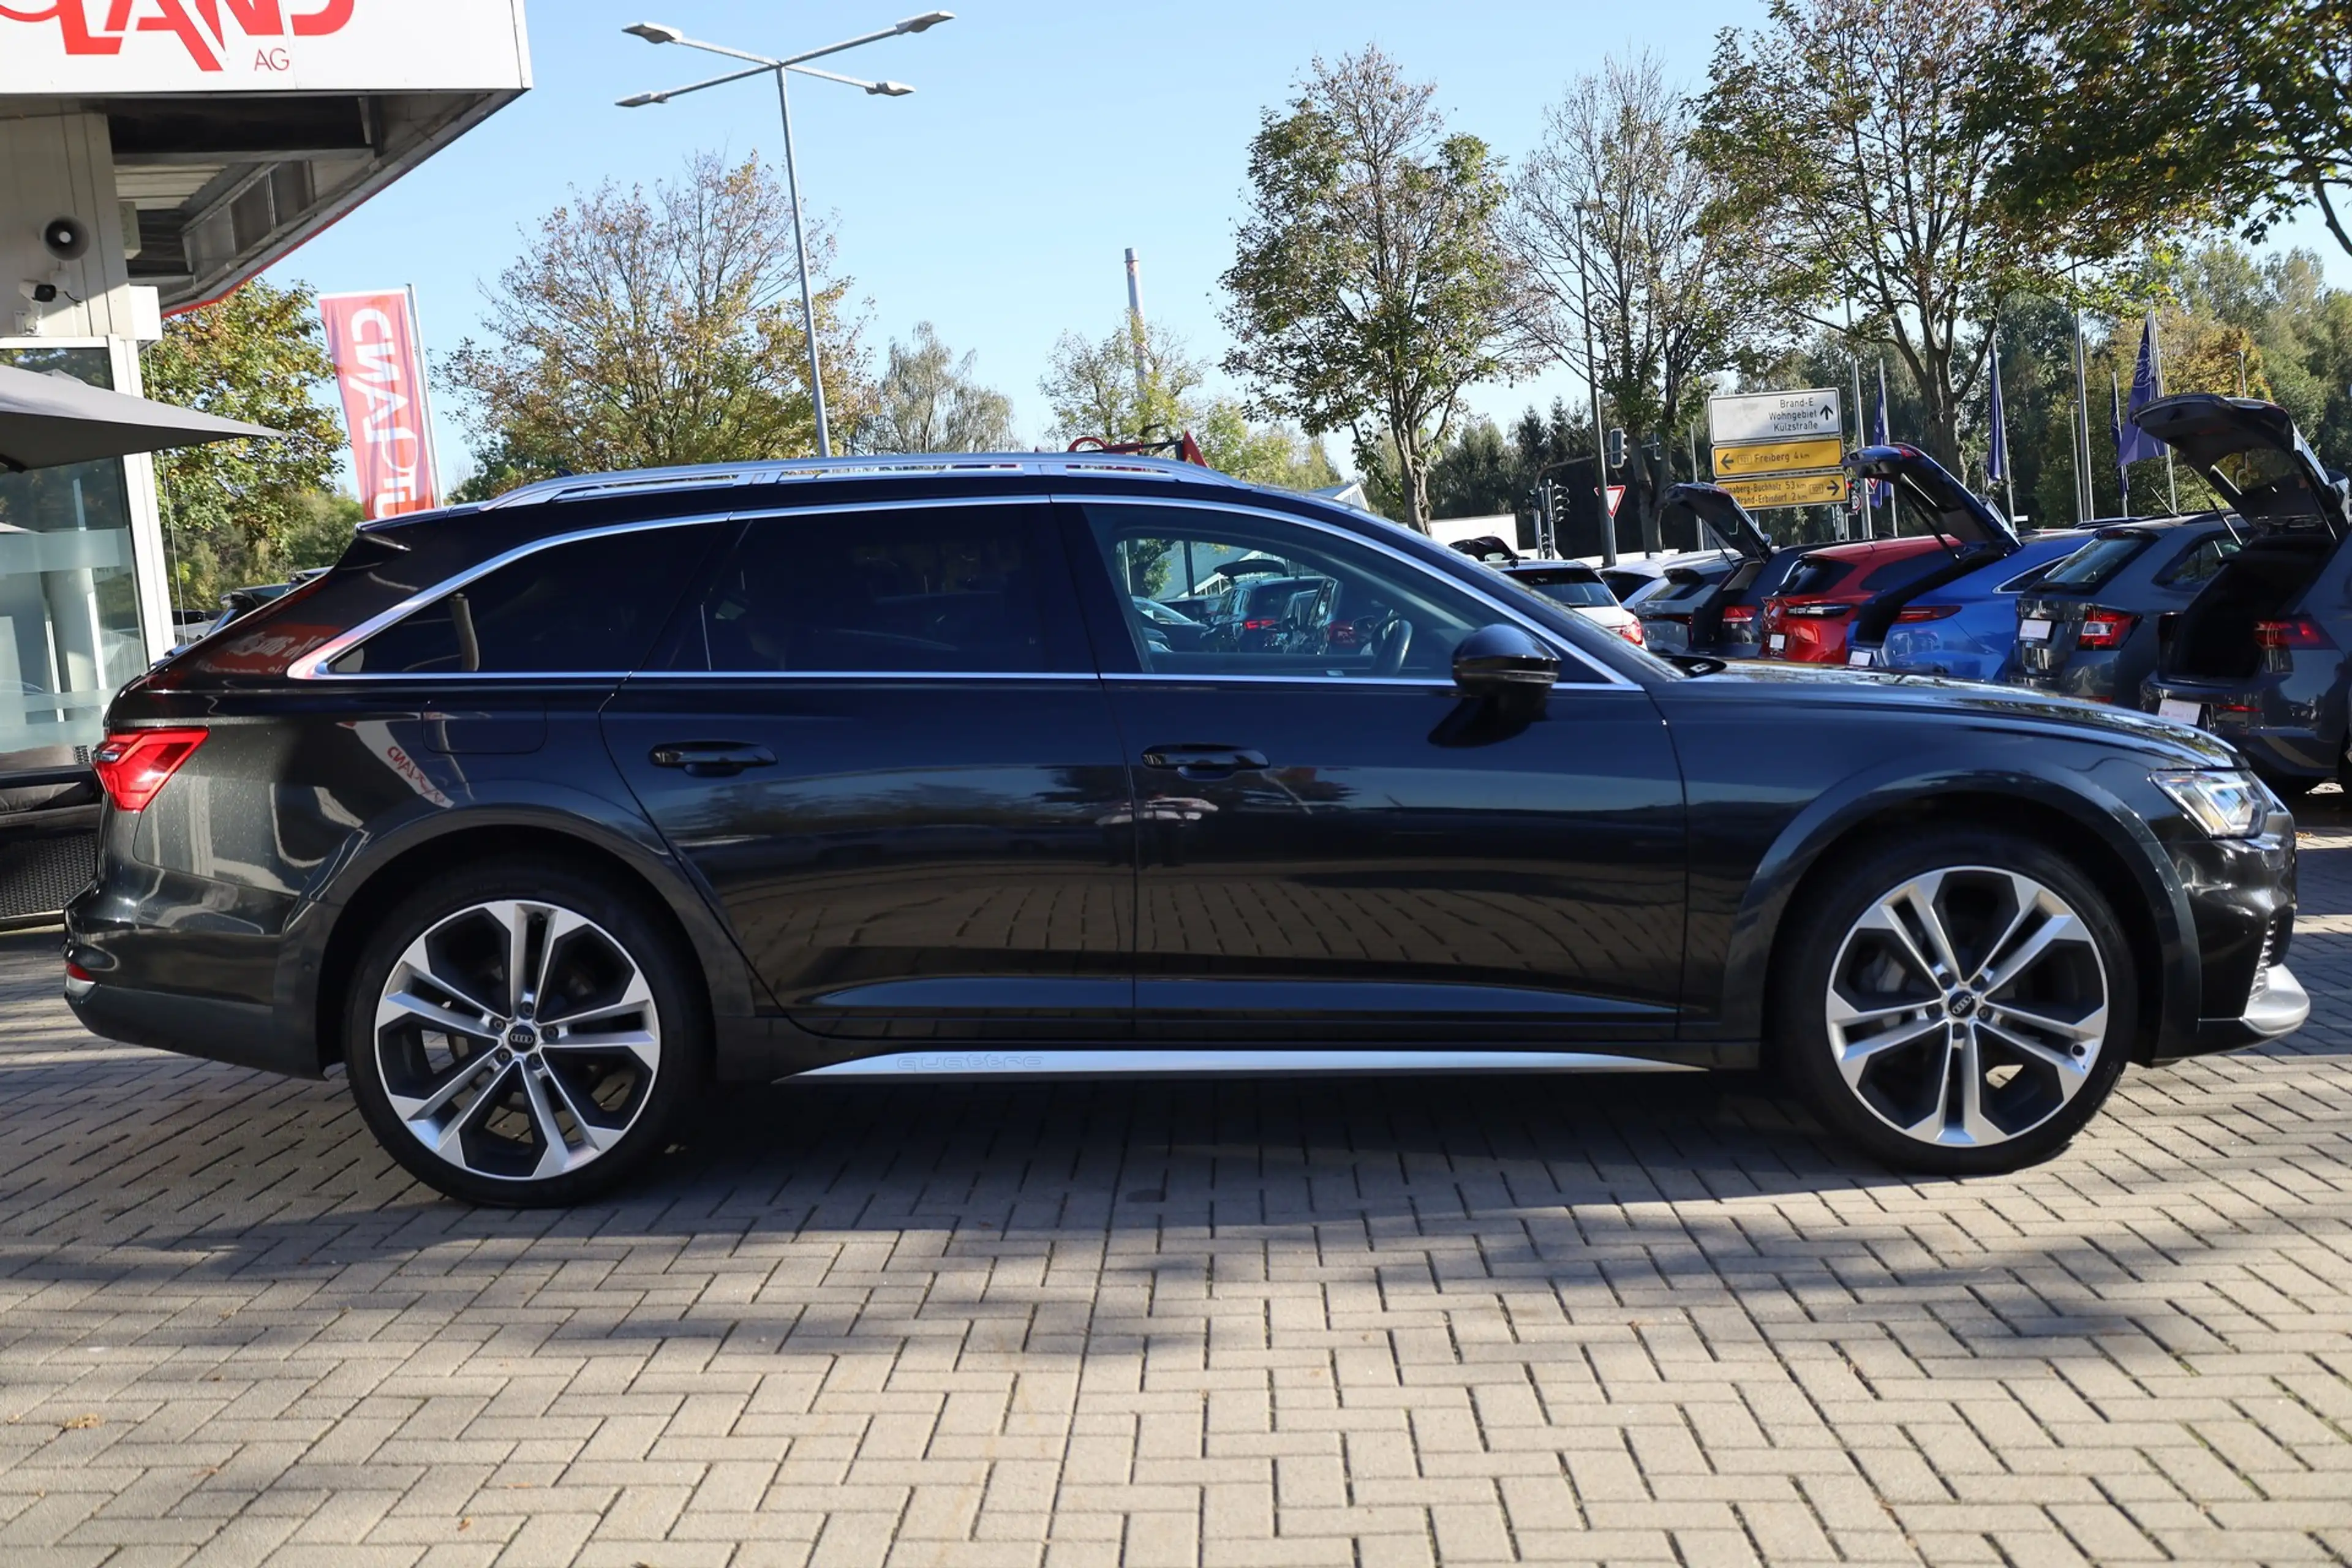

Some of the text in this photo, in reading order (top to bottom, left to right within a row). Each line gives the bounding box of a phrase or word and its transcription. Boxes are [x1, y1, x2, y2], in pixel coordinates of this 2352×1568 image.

[254, 48, 290, 72] AG
[1769, 410, 1817, 421] Wohngebiet
[1754, 453, 1790, 463] Freiberg
[1785, 480, 1795, 489] 53
[1791, 492, 1796, 501] 2
